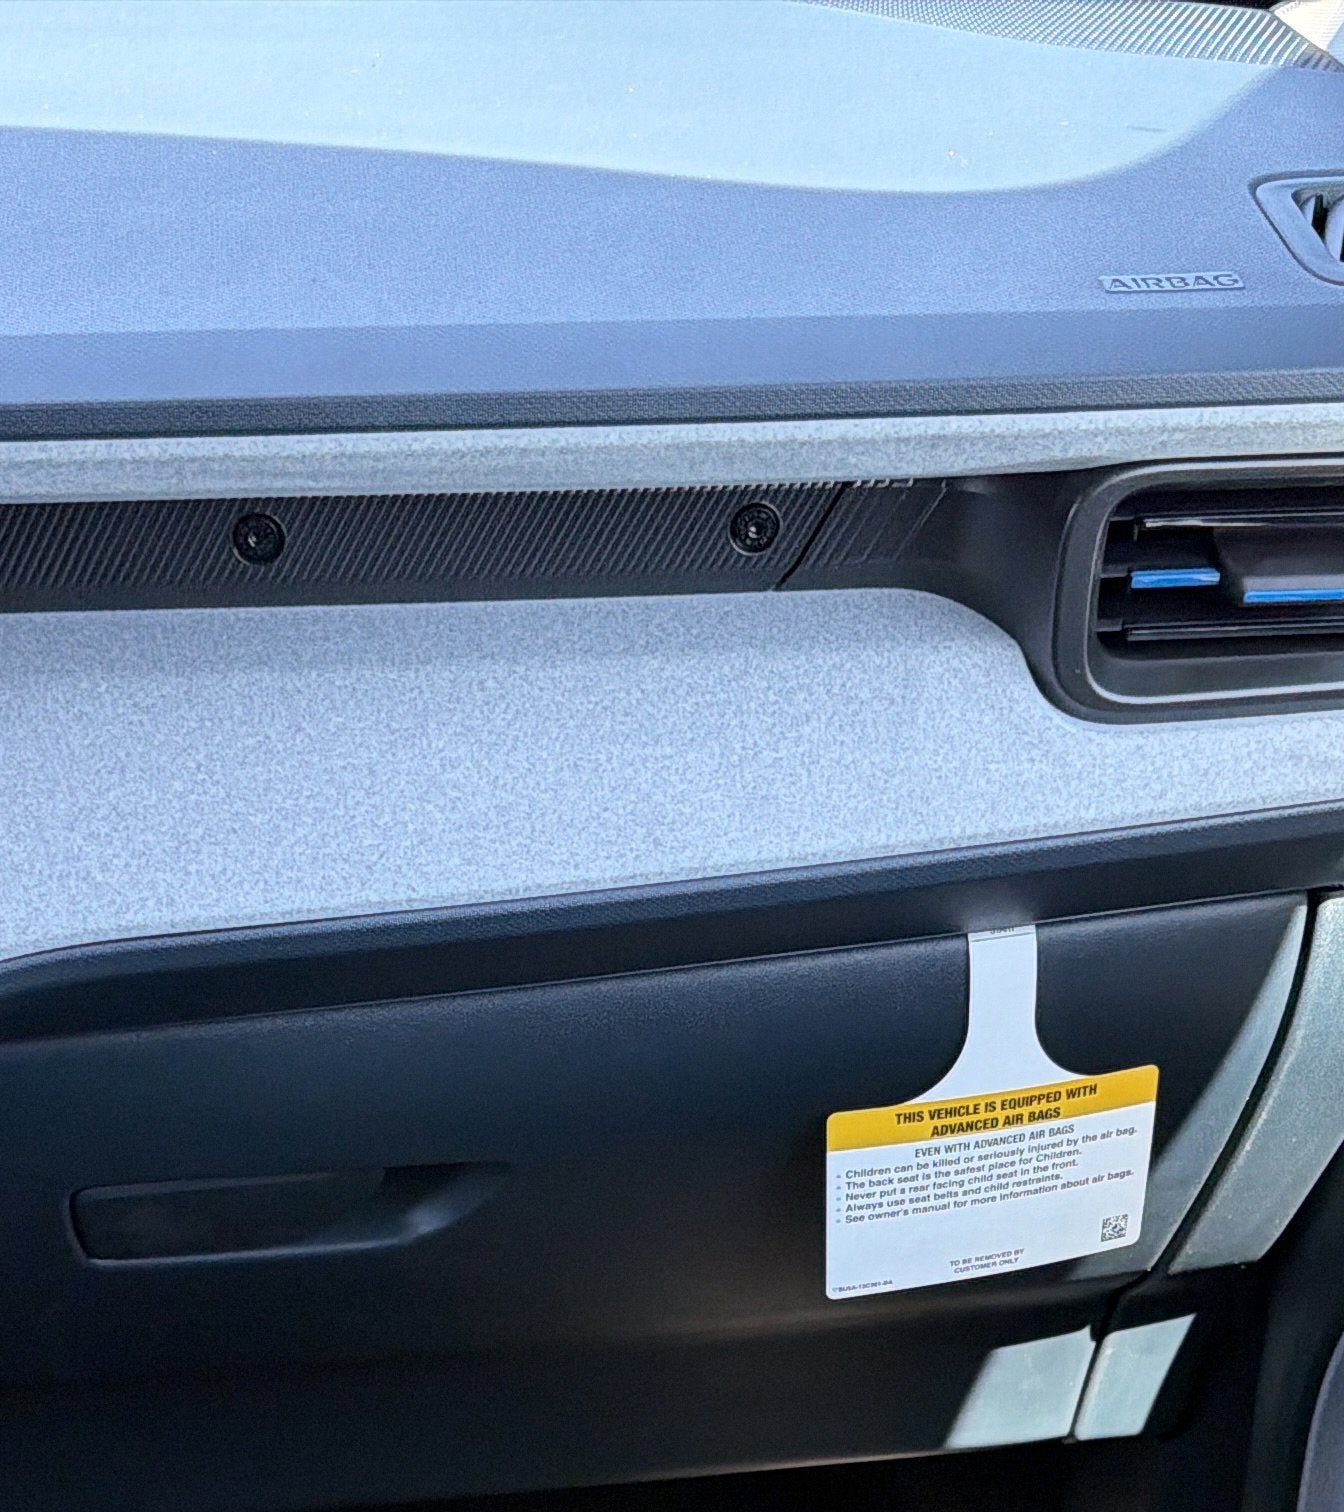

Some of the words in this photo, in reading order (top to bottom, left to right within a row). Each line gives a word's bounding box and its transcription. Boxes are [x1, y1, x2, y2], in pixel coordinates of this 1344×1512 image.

[1109, 274, 1239, 290] AIRBAG
[895, 1111, 925, 1125] THIS
[928, 1103, 981, 1120] VEHICLE
[984, 1101, 997, 1113] IS
[1000, 1091, 1061, 1111] EQUIPPED
[1066, 1083, 1098, 1100] WITH
[930, 1117, 999, 1137] ADVANCED
[1002, 1113, 1024, 1127] AIR
[1027, 1106, 1061, 1122] BAGS
[845, 1166, 891, 1179] Children
[894, 1164, 913, 1173] can
[916, 1161, 930, 1170] be
[932, 1156, 961, 1168] killed
[963, 1155, 975, 1164] or
[978, 1147, 1025, 1162] seriously
[1028, 1140, 1064, 1154] injured
[1066, 1138, 1079, 1148] by
[1081, 1133, 1098, 1144] the
[1100, 1130, 1113, 1140] air
[915, 1146, 941, 1158] EVEN
[944, 1142, 970, 1154] WITH
[973, 1133, 1026, 1150] ADVANCED
[1028, 1129, 1046, 1141] AIR
[1048, 1124, 1075, 1138] BAGS
[845, 1181, 866, 1191] The
[868, 1177, 895, 1188] back
[897, 1174, 919, 1184] seat
[922, 1172, 931, 1181] is
[934, 1168, 951, 1178] the
[954, 1164, 985, 1176] safest
[988, 1160, 1016, 1173] place
[1019, 1155, 1032, 1166] for
[846, 1191, 879, 1202] Never
[879, 1188, 897, 1199] put
[909, 1184, 930, 1194] rear
[933, 1178, 965, 1190] facing
[968, 1172, 993, 1185] child
[996, 1170, 1017, 1180] seat
[1020, 1166, 1030, 1176] in
[1032, 1163, 1049, 1174] the
[845, 1214, 865, 1224] See
[867, 1208, 909, 1221] owner's
[912, 1202, 951, 1215] manual
[953, 1198, 968, 1209] for
[970, 1195, 997, 1206] more
[999, 1185, 1058, 1202] information
[1060, 1177, 1090, 1190] about
[1091, 1173, 1104, 1183] air
[846, 1201, 884, 1213] Always
[886, 1198, 906, 1207] use
[908, 1194, 931, 1204] seat
[933, 1190, 959, 1201] belts
[962, 1186, 981, 1197] and
[984, 1182, 1009, 1194] child
[954, 1262, 997, 1274] CUSTOMER
[998, 1257, 1019, 1267] ONLY
[974, 1251, 1013, 1262] REMOVED
